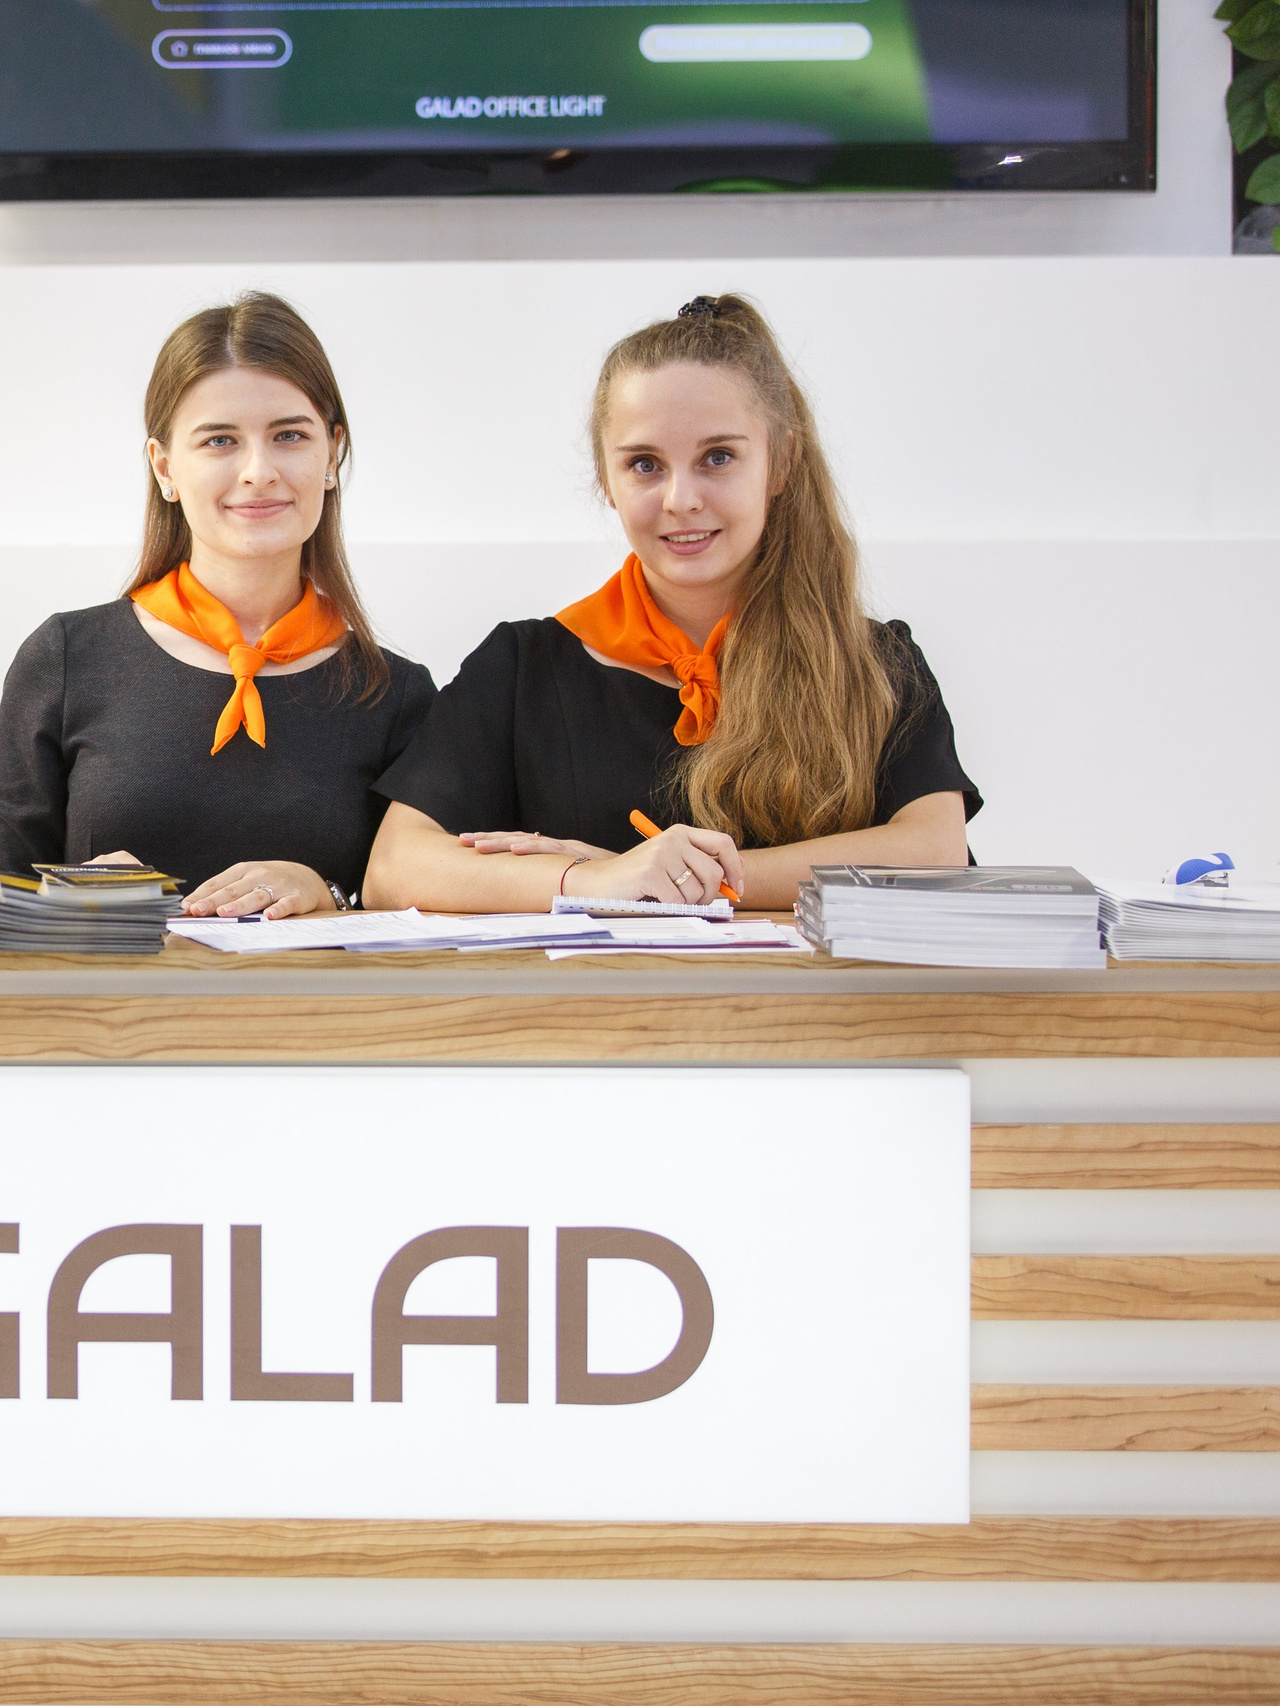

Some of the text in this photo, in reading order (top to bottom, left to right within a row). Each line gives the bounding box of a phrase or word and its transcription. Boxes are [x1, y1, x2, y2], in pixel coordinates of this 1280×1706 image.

[415, 95, 607, 119] GALAD OFFICE LIGHT
